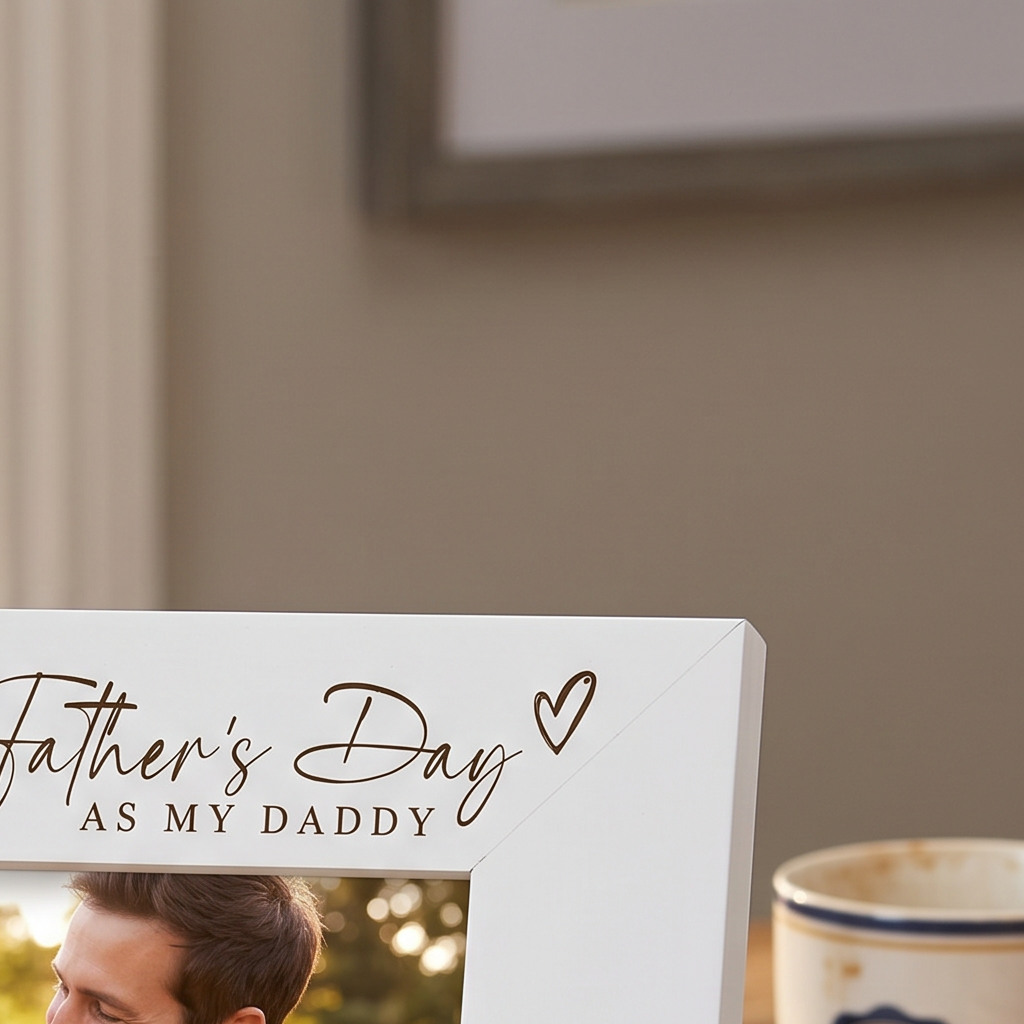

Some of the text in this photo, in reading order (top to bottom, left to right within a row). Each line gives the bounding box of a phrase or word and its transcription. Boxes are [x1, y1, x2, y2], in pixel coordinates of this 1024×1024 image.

[293, 682, 523, 827] Day
[79, 801, 436, 837] AS MY DADDY
